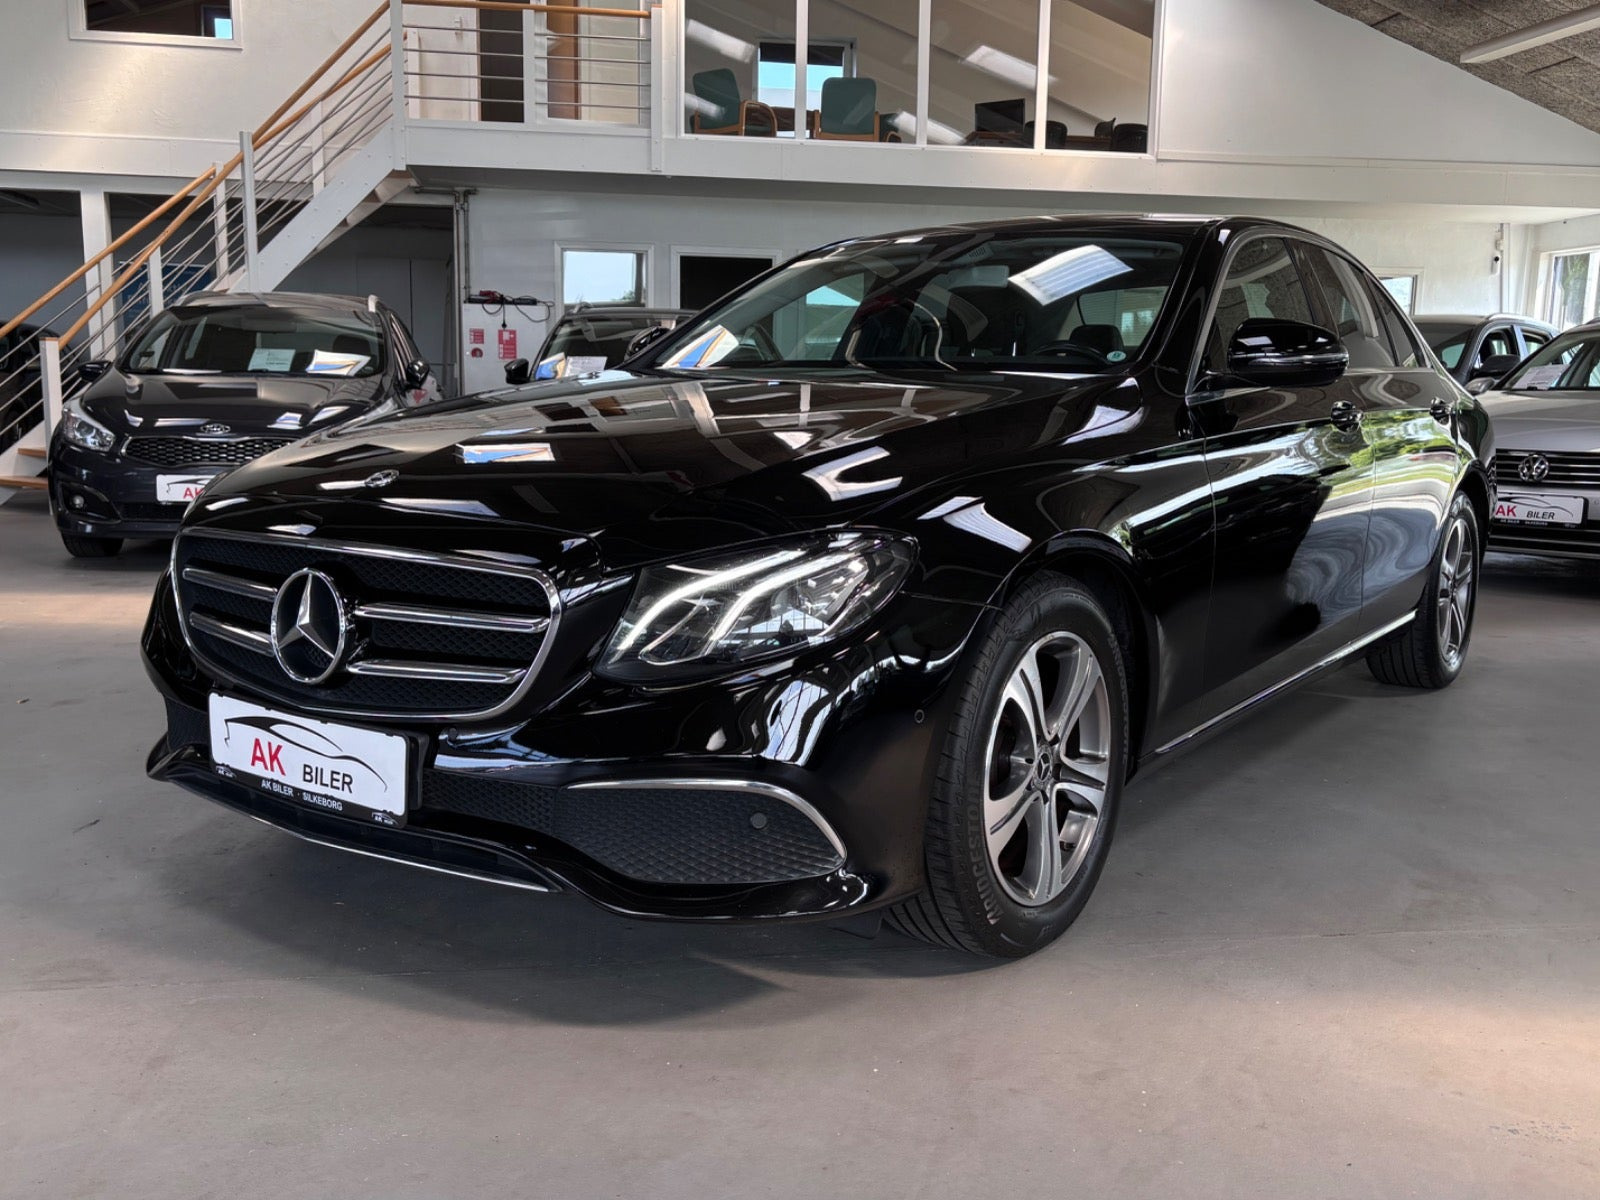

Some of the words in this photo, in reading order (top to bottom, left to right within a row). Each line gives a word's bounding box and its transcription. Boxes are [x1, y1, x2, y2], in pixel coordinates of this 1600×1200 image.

[1495, 504, 1517, 518] AK
[1526, 510, 1556, 520] BILER
[250, 737, 286, 776] AK
[302, 763, 353, 794] BILER
[260, 779, 272, 791] AK
[272, 783, 294, 798] BILER
[302, 792, 343, 811] SILKEBORG
